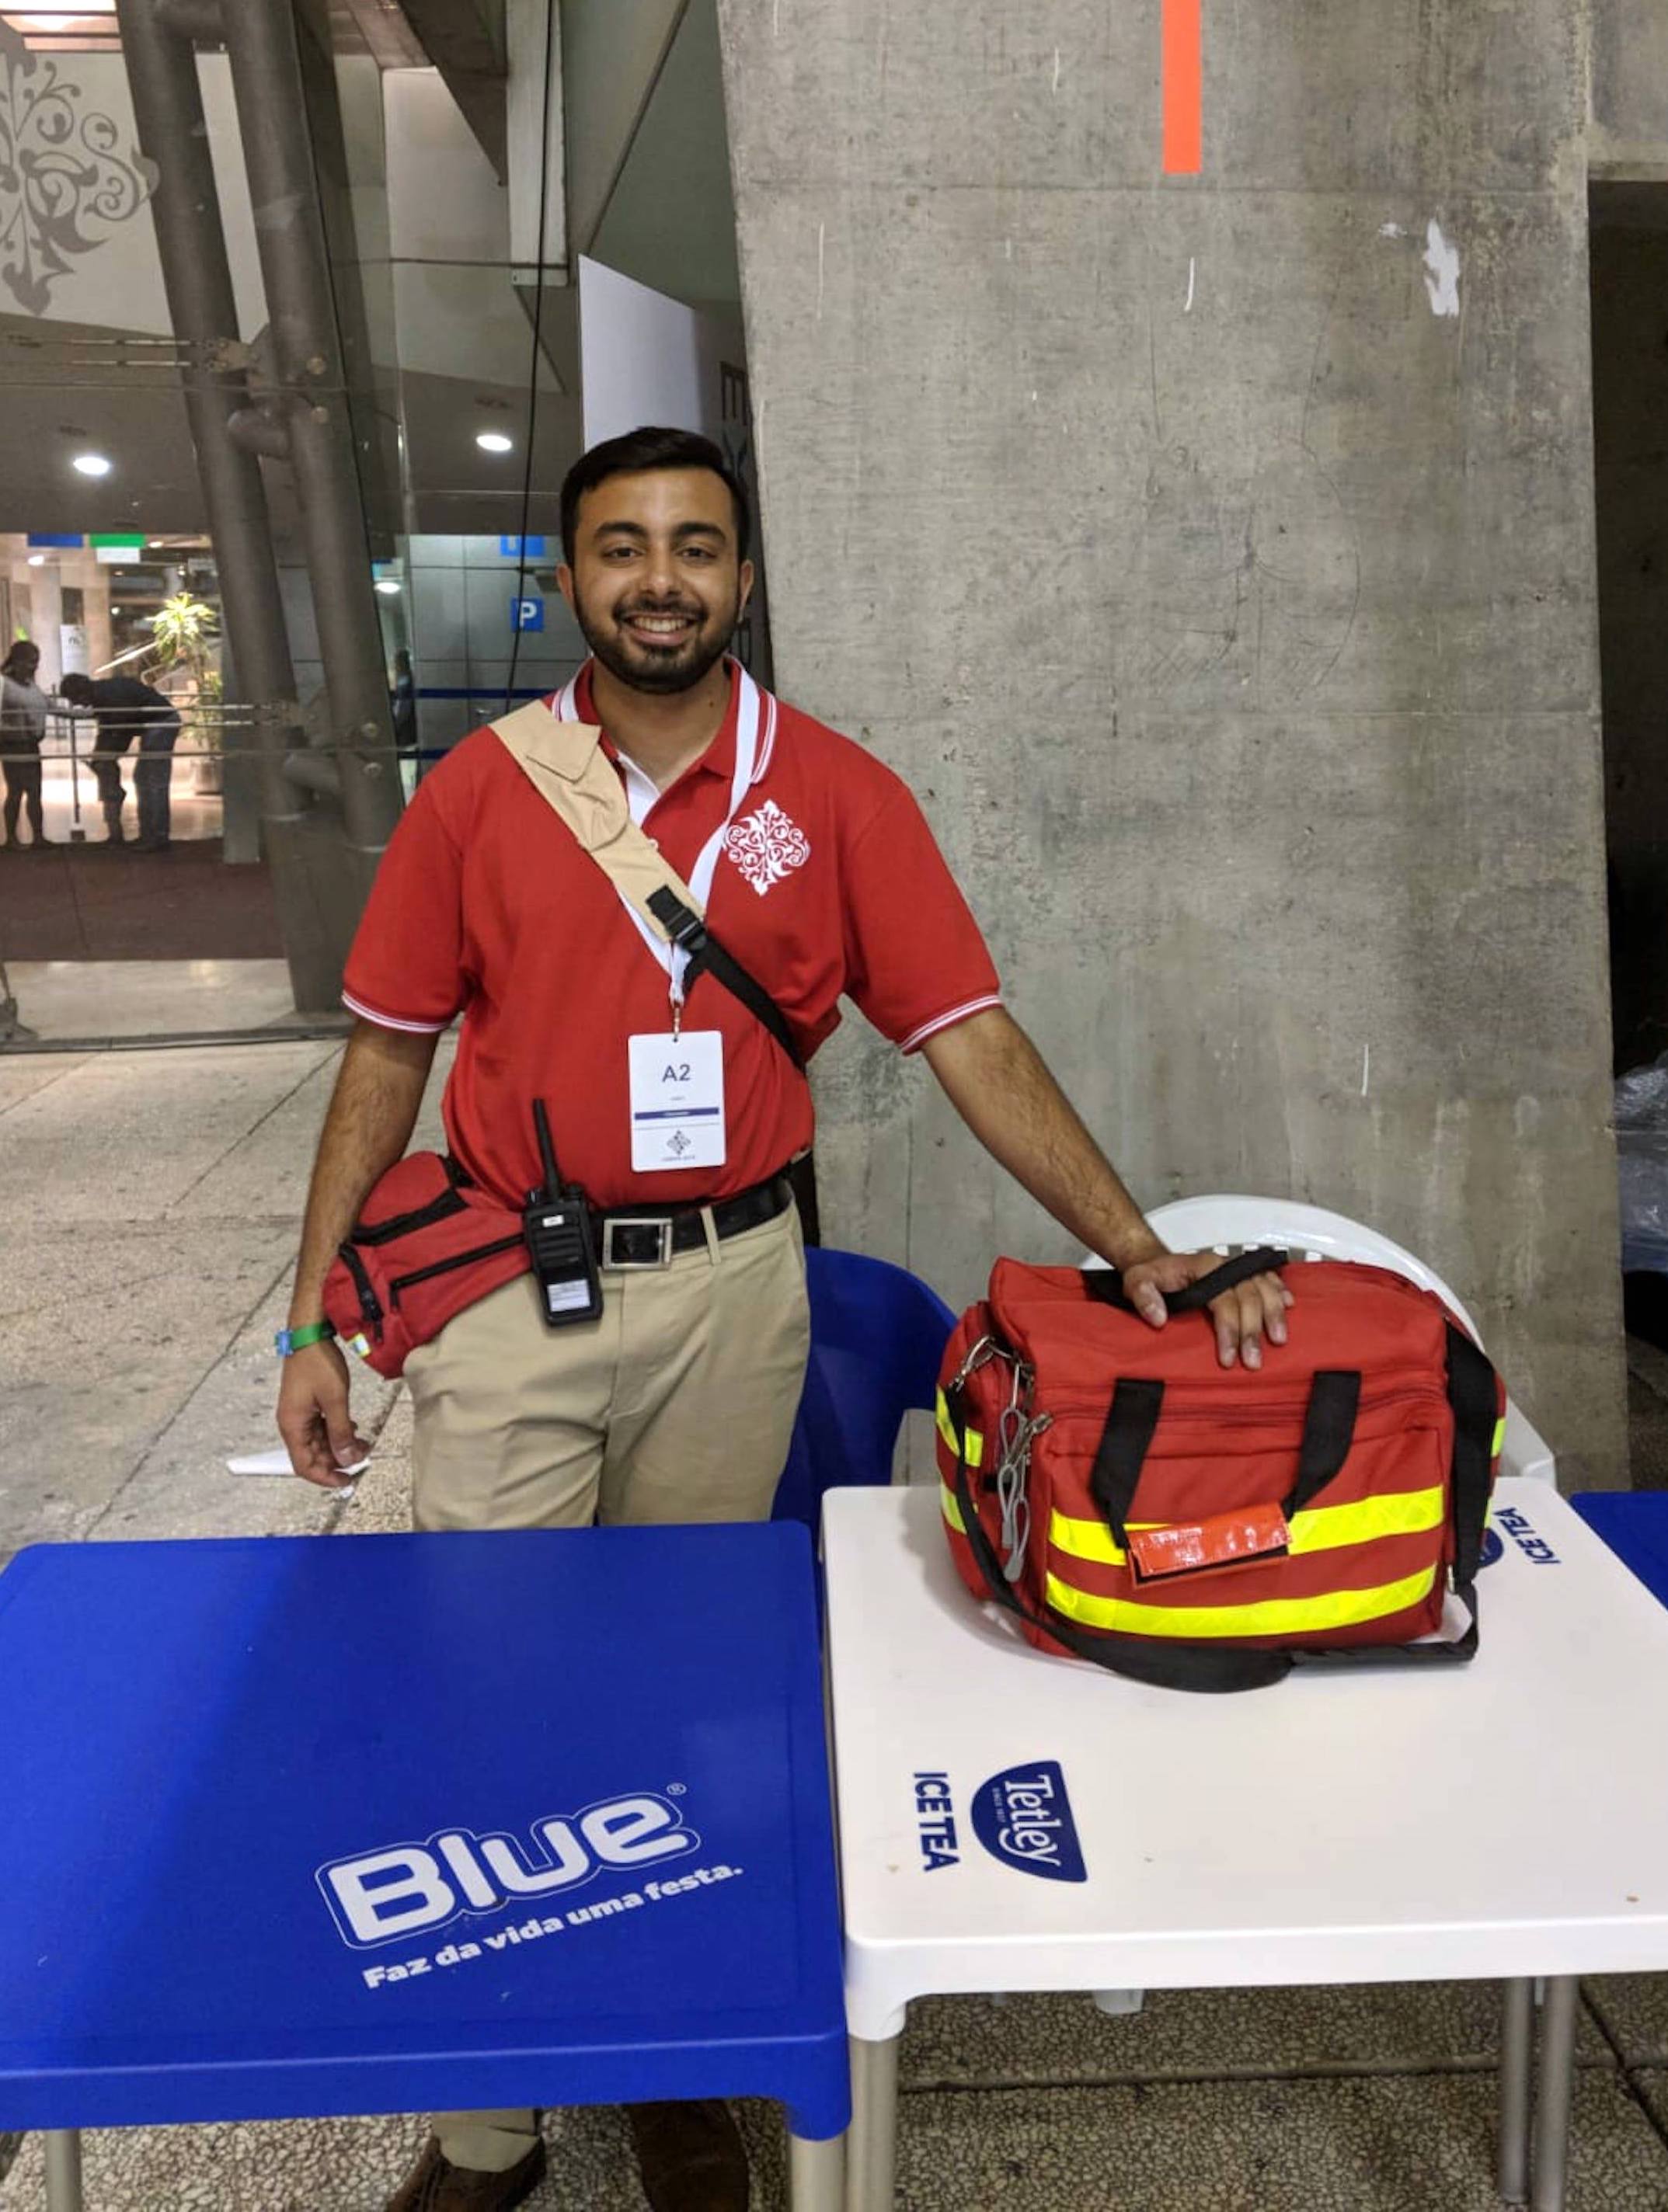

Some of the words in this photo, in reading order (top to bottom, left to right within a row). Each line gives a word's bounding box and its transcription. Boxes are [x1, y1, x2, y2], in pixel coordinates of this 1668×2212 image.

[520, 600, 538, 628] P
[661, 1063, 691, 1083] A2
[1493, 1507, 1537, 1538] TEA
[1515, 1538, 1562, 1564] ICE
[913, 1772, 953, 1814] ICE
[998, 1774, 1063, 1867] Tetley
[918, 1815, 960, 1873] TEA
[326, 1796, 691, 1942] Blue
[361, 1957, 433, 1989] Faz
[434, 1943, 483, 1967] da
[482, 1918, 565, 1949] vida
[566, 1892, 645, 1925] uma
[643, 1865, 744, 1901] festa.
